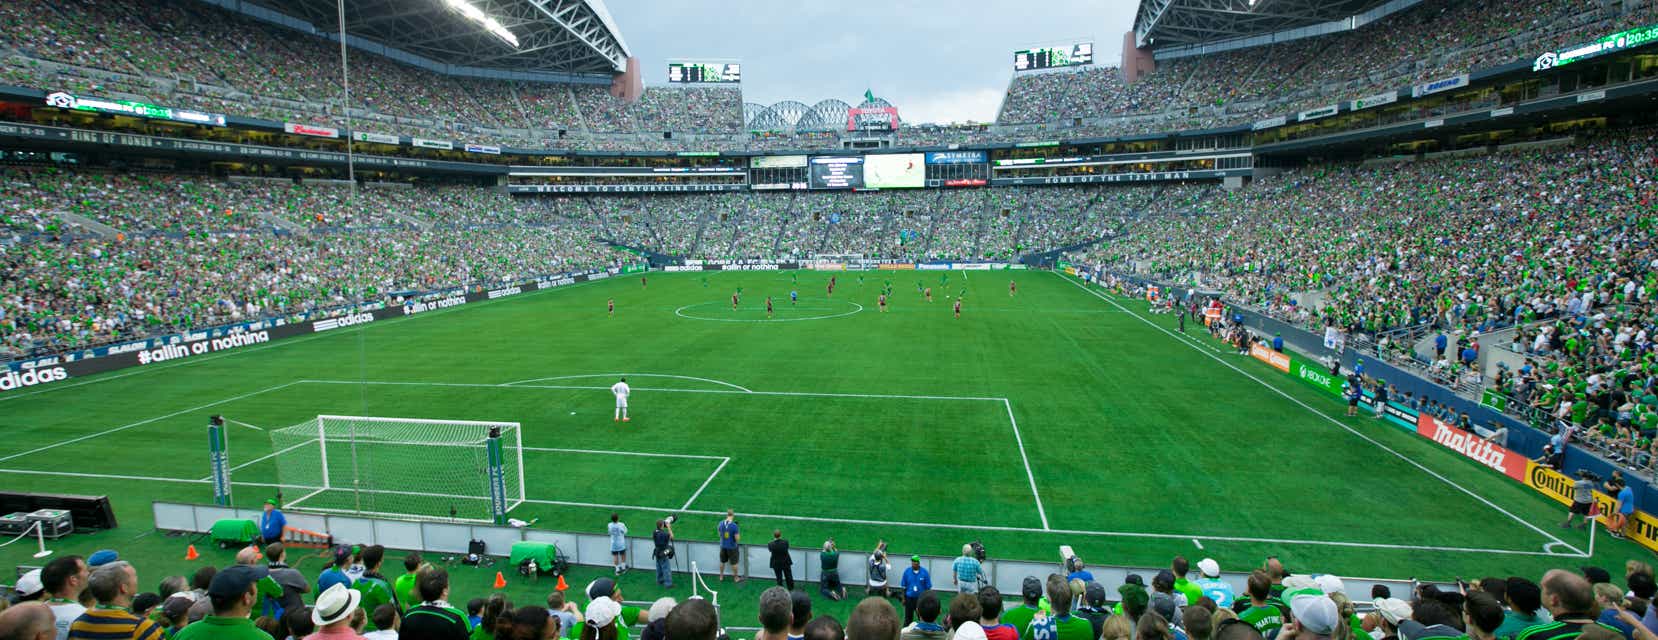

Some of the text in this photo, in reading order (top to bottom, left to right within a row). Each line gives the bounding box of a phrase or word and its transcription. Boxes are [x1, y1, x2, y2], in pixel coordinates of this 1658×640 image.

[1629, 28, 1658, 45] 20:35
[71, 131, 153, 147] RING OF HONOR
[1045, 172, 1190, 184] HOME OF THE 12TH MAN
[337, 312, 374, 328] adidas
[428, 301, 437, 311] or
[437, 295, 467, 309] nothing
[138, 340, 190, 366] #allin
[192, 339, 209, 354] or
[211, 328, 270, 351] nothing
[1531, 465, 1616, 517] Continal
